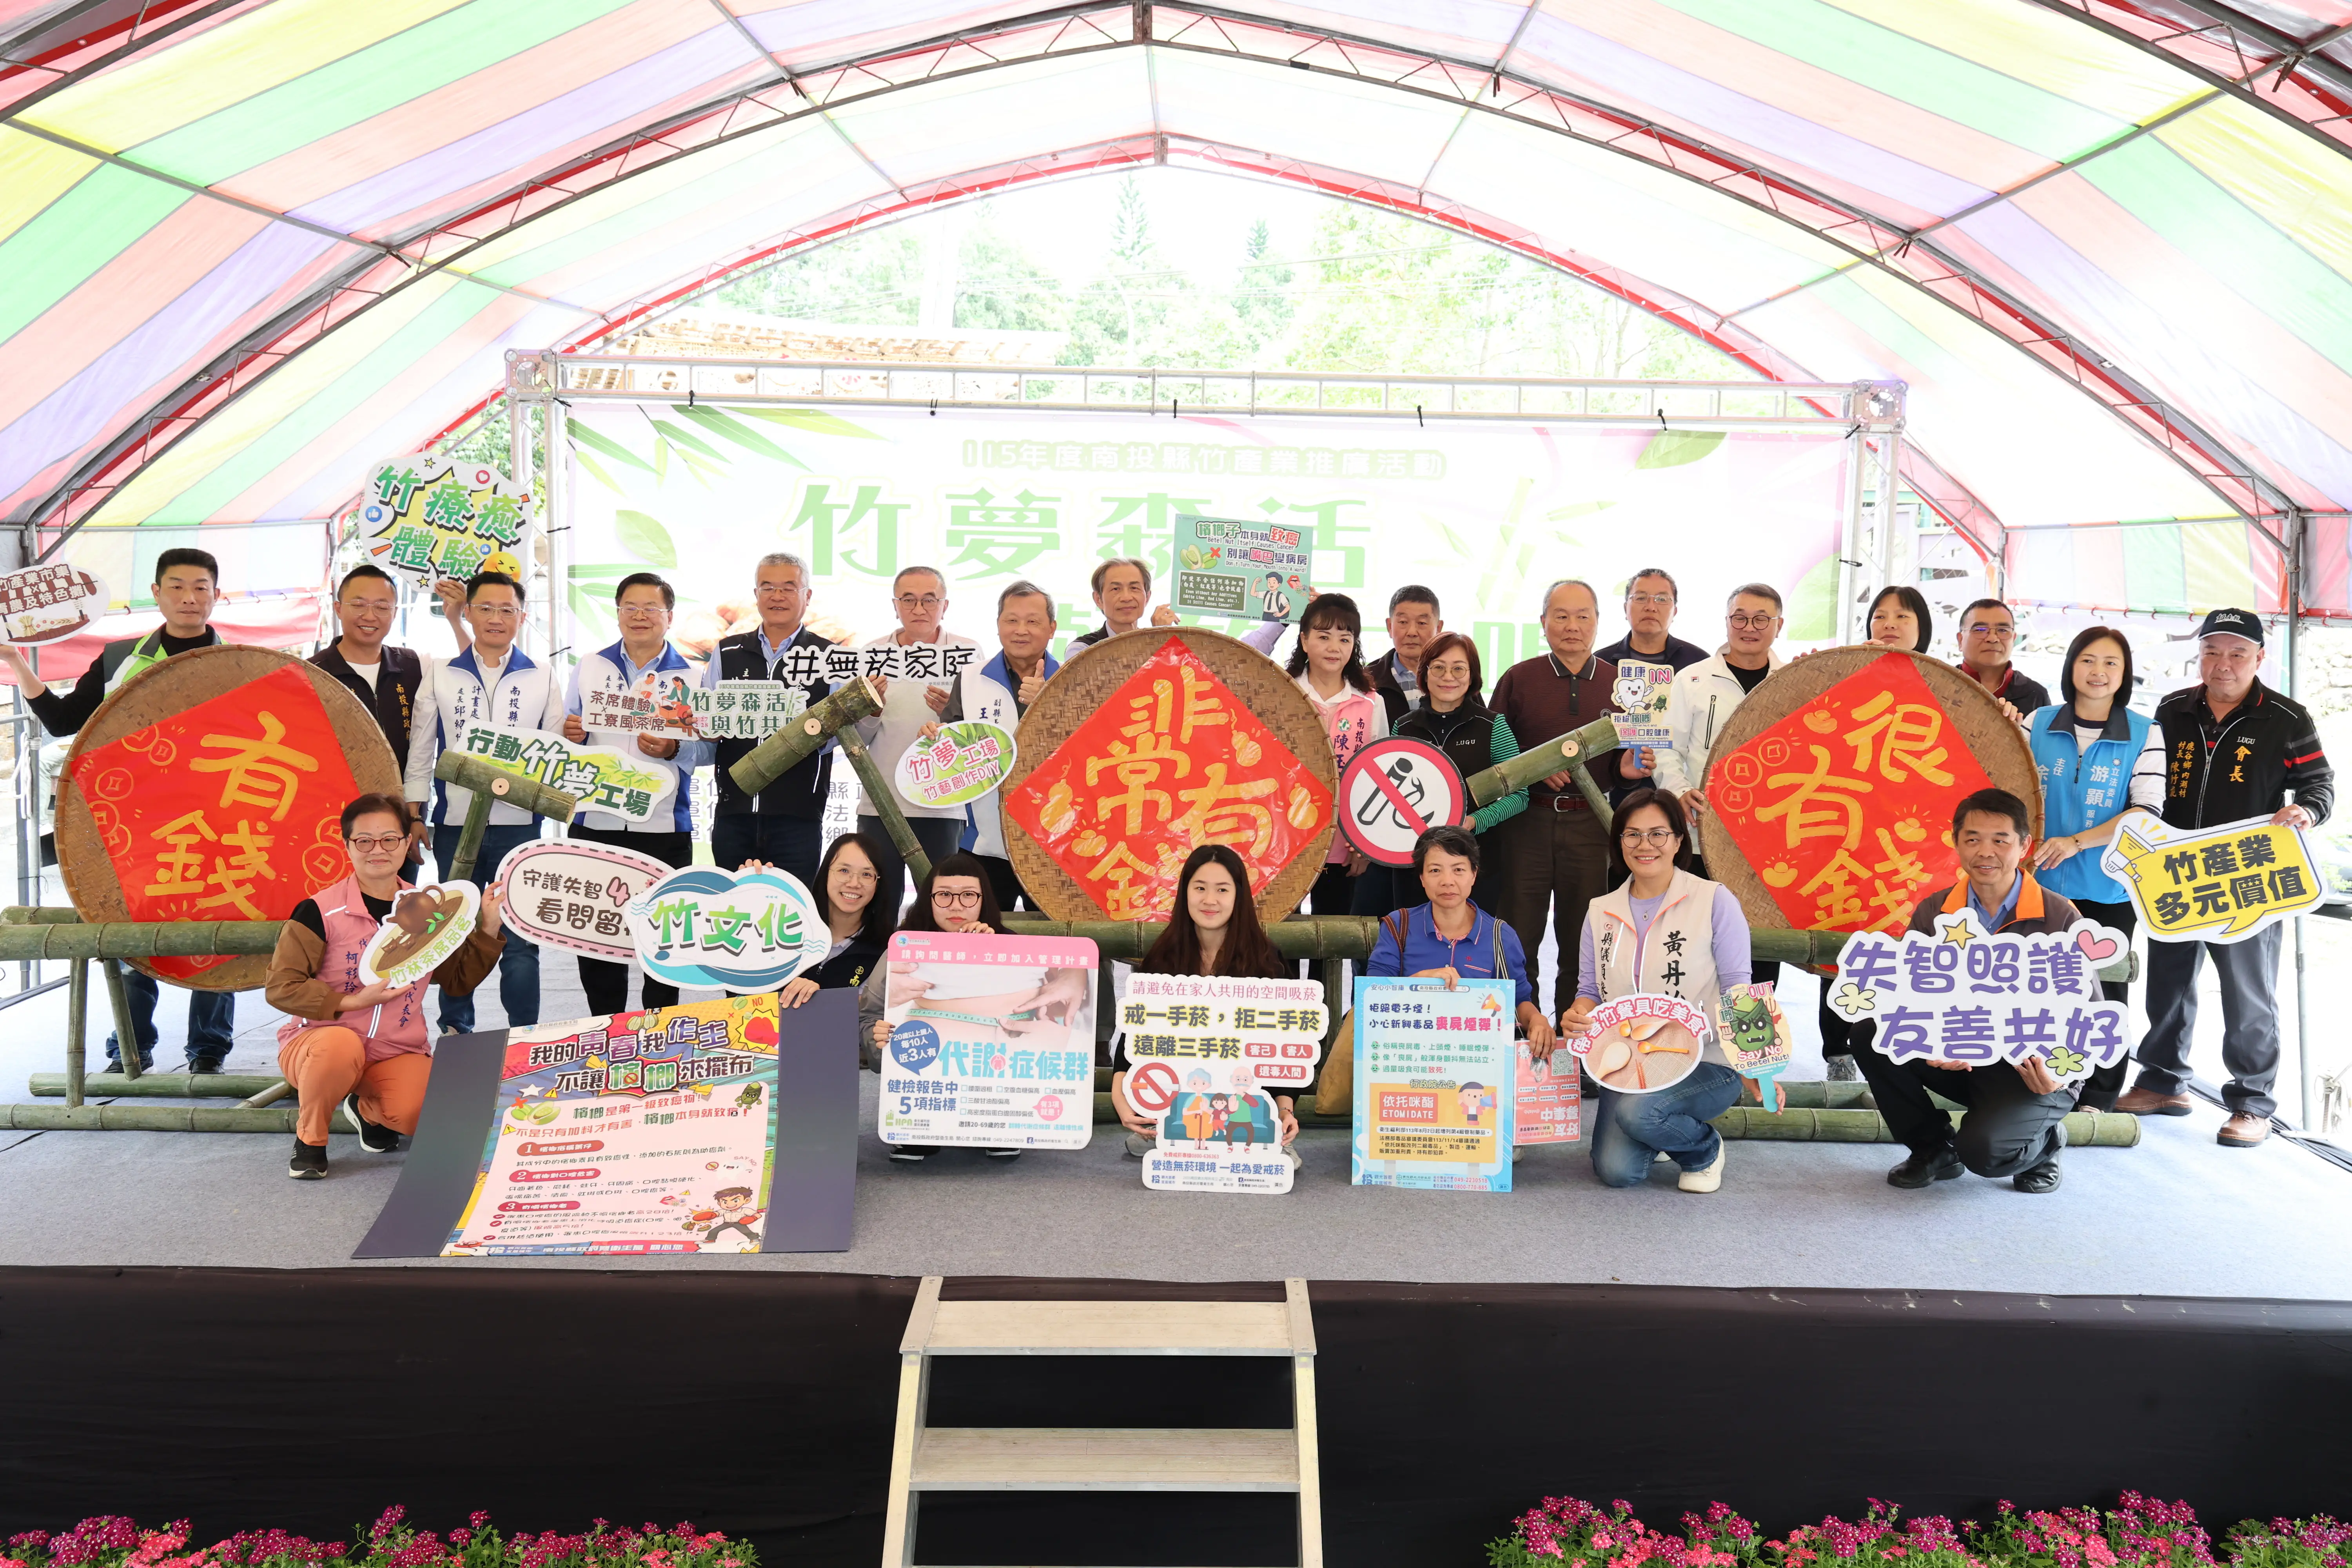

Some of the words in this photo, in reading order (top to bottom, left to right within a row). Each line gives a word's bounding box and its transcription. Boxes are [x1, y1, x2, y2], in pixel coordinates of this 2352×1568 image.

[965, 442, 1441, 477] 115年度南投縣竹產業推廣活動
[374, 464, 523, 541] 竹療癒
[1198, 523, 1299, 546] 檳榔子本身就致癌
[391, 525, 482, 580] 體驗
[1227, 548, 1307, 565] 別讓嘴巴變病房
[788, 646, 976, 680] #無菸家庭
[1621, 666, 1646, 678] 健康
[1649, 669, 1672, 684] IN
[457, 687, 465, 703] 處長
[470, 685, 481, 719] 計畫處
[590, 690, 652, 713] 茶席體驗
[691, 692, 786, 712] 竹夢森活
[507, 686, 521, 727] 南投縣
[588, 713, 666, 732] 工寮風茶席
[711, 715, 797, 735] 與竹共
[1614, 714, 1651, 723] 拒絕檳榔
[1620, 728, 1670, 737] 保護口腔健康
[2236, 736, 2256, 744] LUGU
[909, 739, 999, 781] 竹夢工場
[2053, 758, 2066, 776] 主任
[2229, 745, 2252, 782] 會長
[466, 727, 652, 817] 行動竹夢工場
[924, 760, 1000, 800] 竹藝創作DIY
[2104, 767, 2120, 808] 立法委員
[2163, 833, 2277, 886] 竹產業
[523, 869, 644, 907] 守護失智4
[2154, 866, 2307, 926] 多元價值
[535, 897, 632, 936] 看問留
[651, 898, 804, 952] 竹文化
[391, 915, 472, 985] 竹林茶席品茗
[901, 949, 1089, 966] 請詢問醫師，立即加入管理計畫
[344, 951, 359, 993] 柯彩玲
[1844, 940, 2083, 996] 失智照護
[1132, 980, 1317, 1002] 請避免在家人共用的空間吸菸
[1748, 981, 1775, 998] OUT
[752, 997, 763, 1007] NO
[1719, 994, 1734, 1022] 檳榔
[1125, 1004, 1320, 1031] 戒一手菸，拒二手菸
[530, 1018, 730, 1065] 我的青春我作主
[901, 1037, 929, 1049] 每10人
[1879, 1004, 2122, 1062] 友善共好
[898, 1047, 936, 1063] 近3人有
[1134, 1034, 1241, 1059] 遠離三手菸
[1250, 1045, 1271, 1056] 害己
[1286, 1045, 1308, 1057] 害人
[1738, 1049, 1762, 1061] Say
[1764, 1045, 1782, 1056] No
[938, 1040, 1089, 1081] 代謝症候群
[1747, 1058, 1770, 1067] Betel
[555, 1054, 754, 1091] 不讓檳榔來擺布
[1259, 1067, 1301, 1078] 遺毒人間
[887, 1079, 958, 1094] 健檢報告中
[1409, 1079, 1456, 1089] 行政院公告
[899, 1096, 956, 1115] 5項指標
[967, 1097, 1010, 1105] 三酸甘油酯偏高
[1383, 1095, 1434, 1108] 依托咪酯
[967, 1109, 1034, 1118] 高密度脂蛋白膽固醇偏低
[1382, 1109, 1434, 1119] ETOMIDATE
[1554, 1122, 1579, 1137] 好友
[1151, 1160, 1216, 1173] 營造無菸環境
[1219, 1162, 1285, 1176] 一起為愛戒菸
